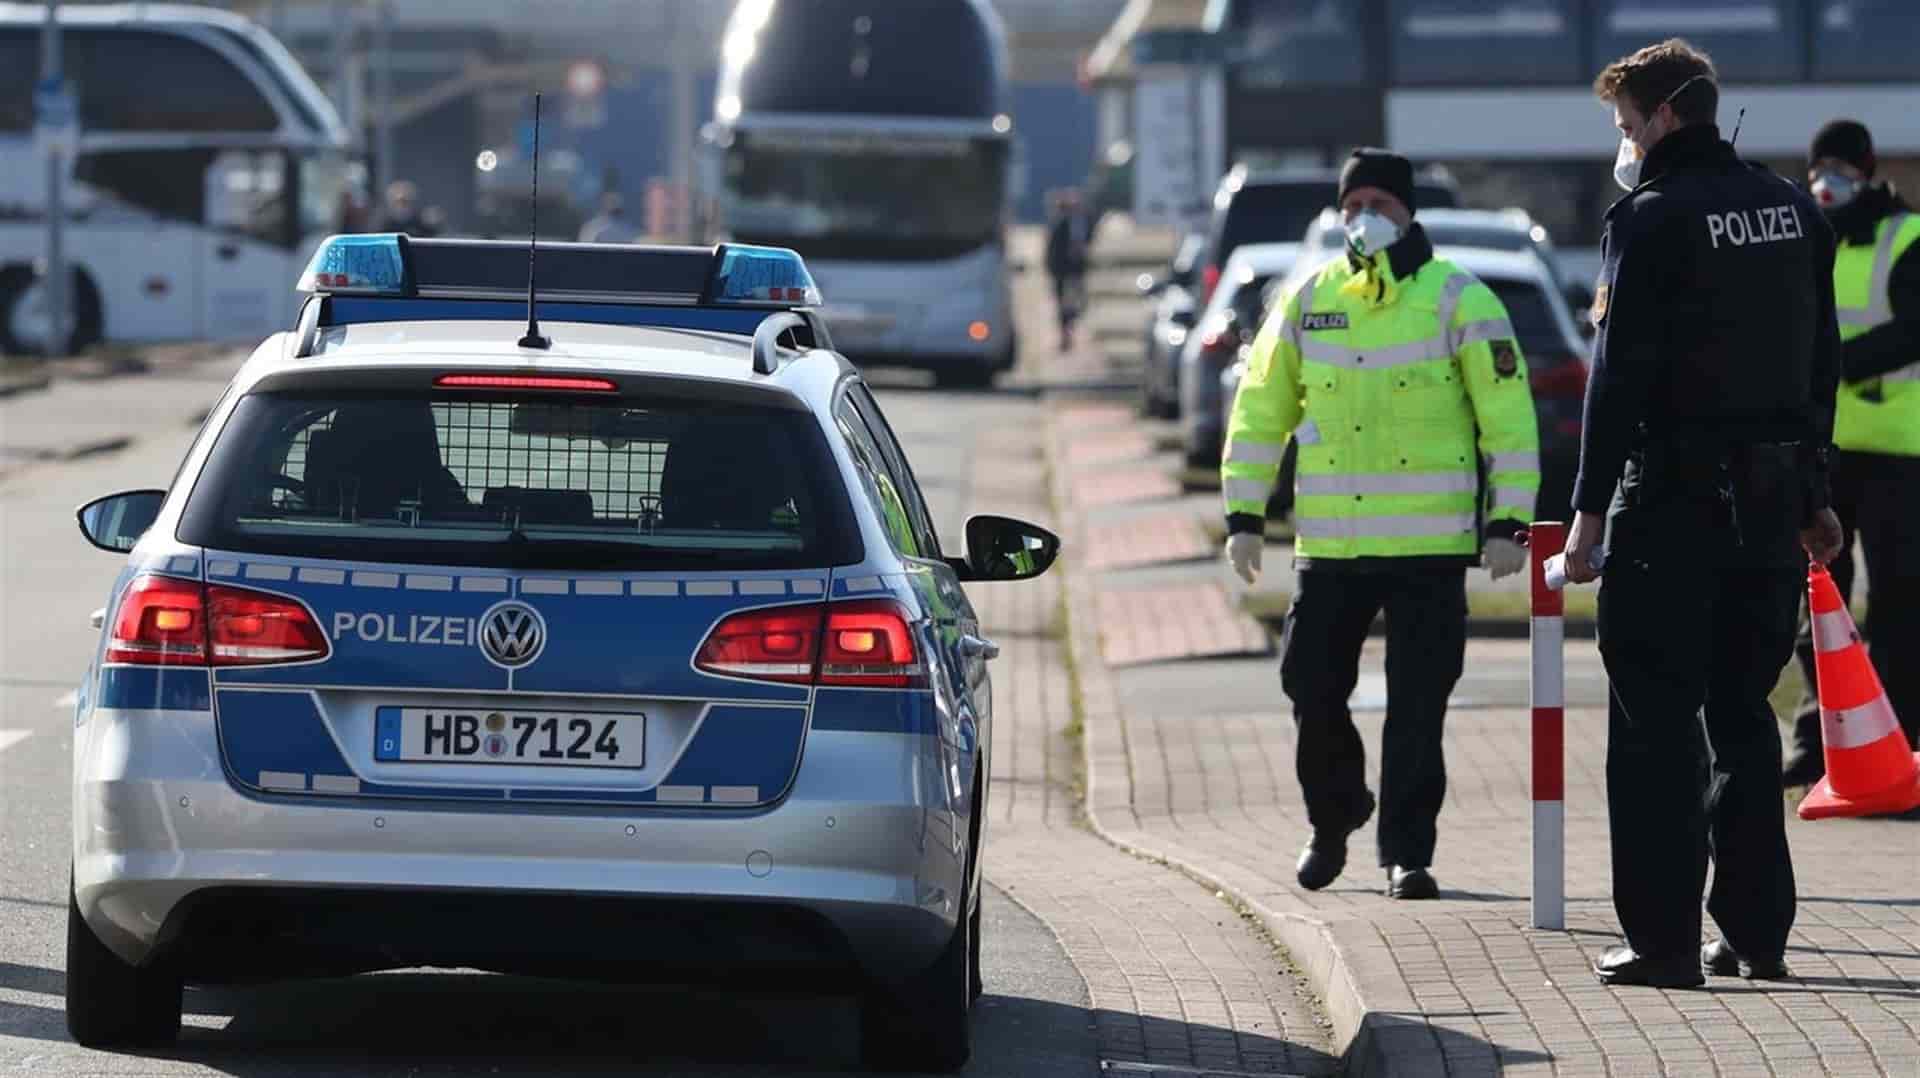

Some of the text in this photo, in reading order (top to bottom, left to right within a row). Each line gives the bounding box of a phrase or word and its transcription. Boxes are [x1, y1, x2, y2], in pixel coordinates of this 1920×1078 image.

[1706, 205, 1803, 249] POLIZEI
[333, 612, 476, 646] POLIZEI
[424, 714, 619, 760] HB 7124
